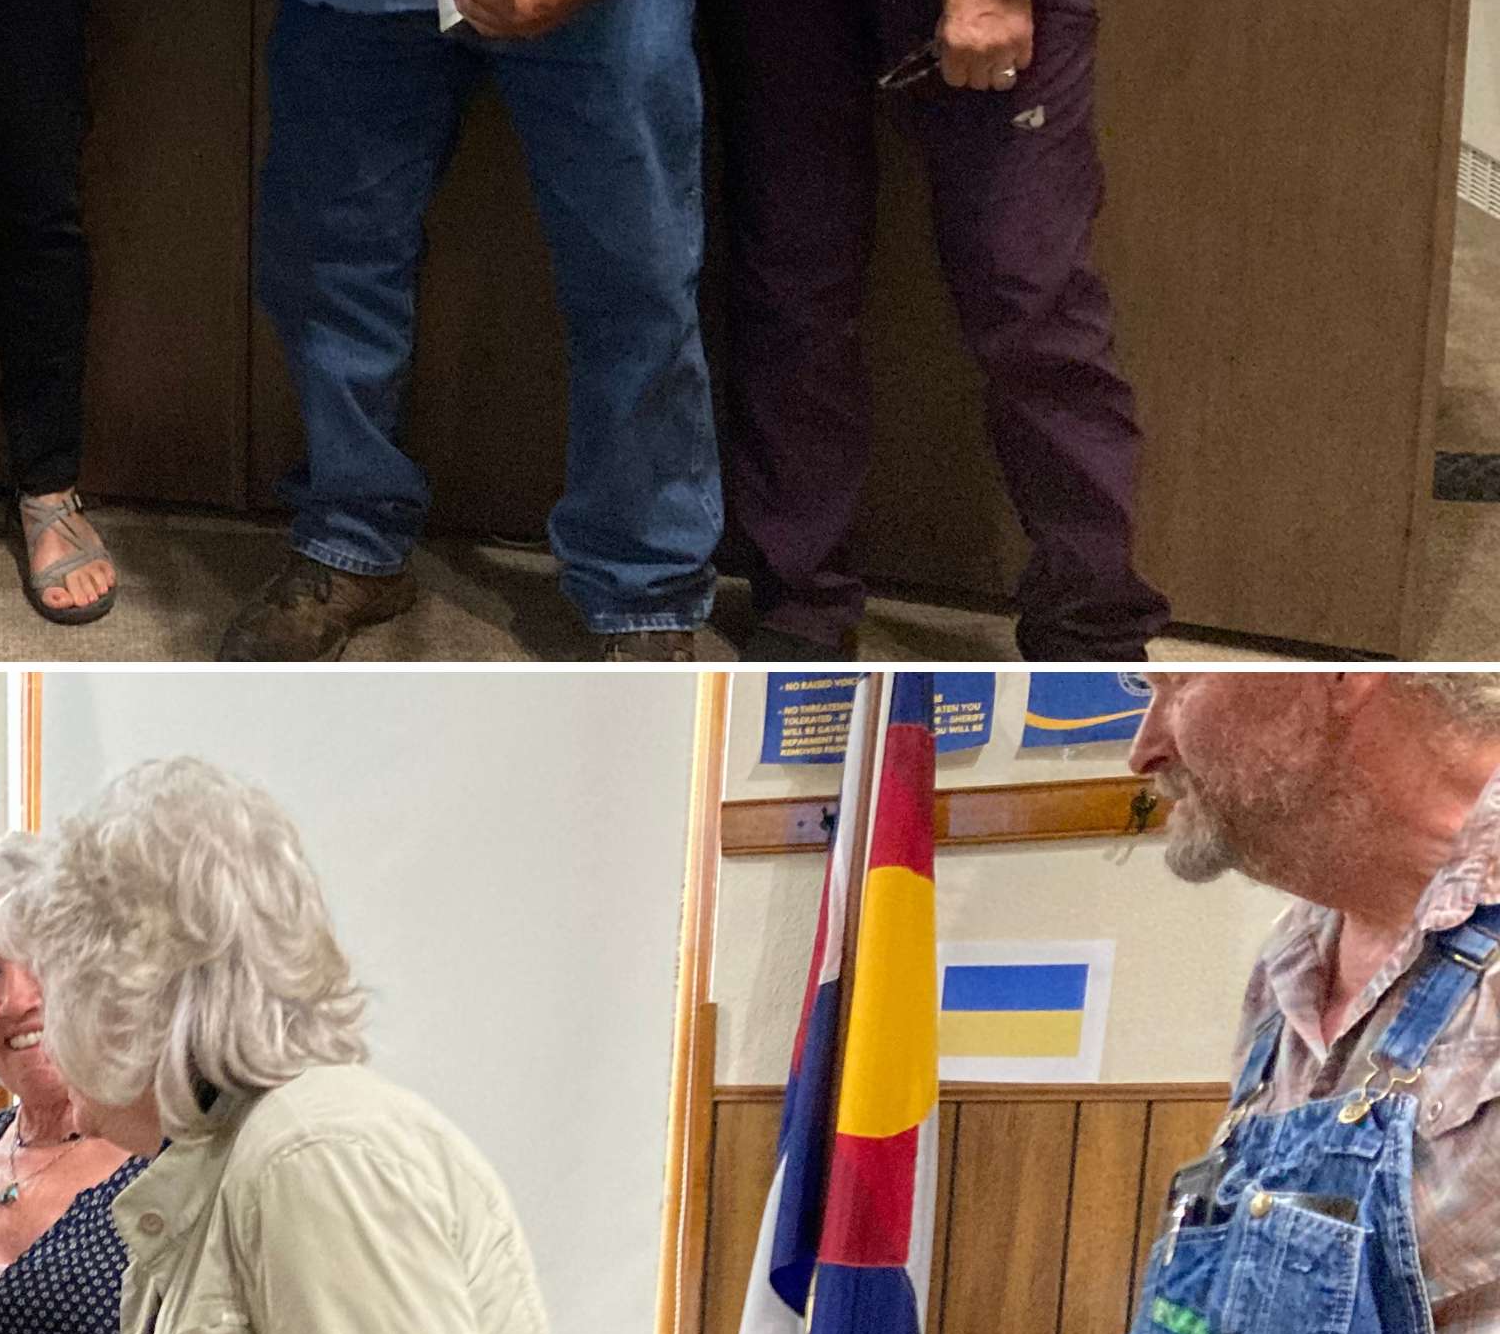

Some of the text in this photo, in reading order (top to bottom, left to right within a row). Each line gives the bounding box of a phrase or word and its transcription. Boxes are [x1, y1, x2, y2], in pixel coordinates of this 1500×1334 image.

[785, 679, 833, 692] NO RAISED
[784, 705, 799, 715] NO
[962, 702, 982, 712] YOU
